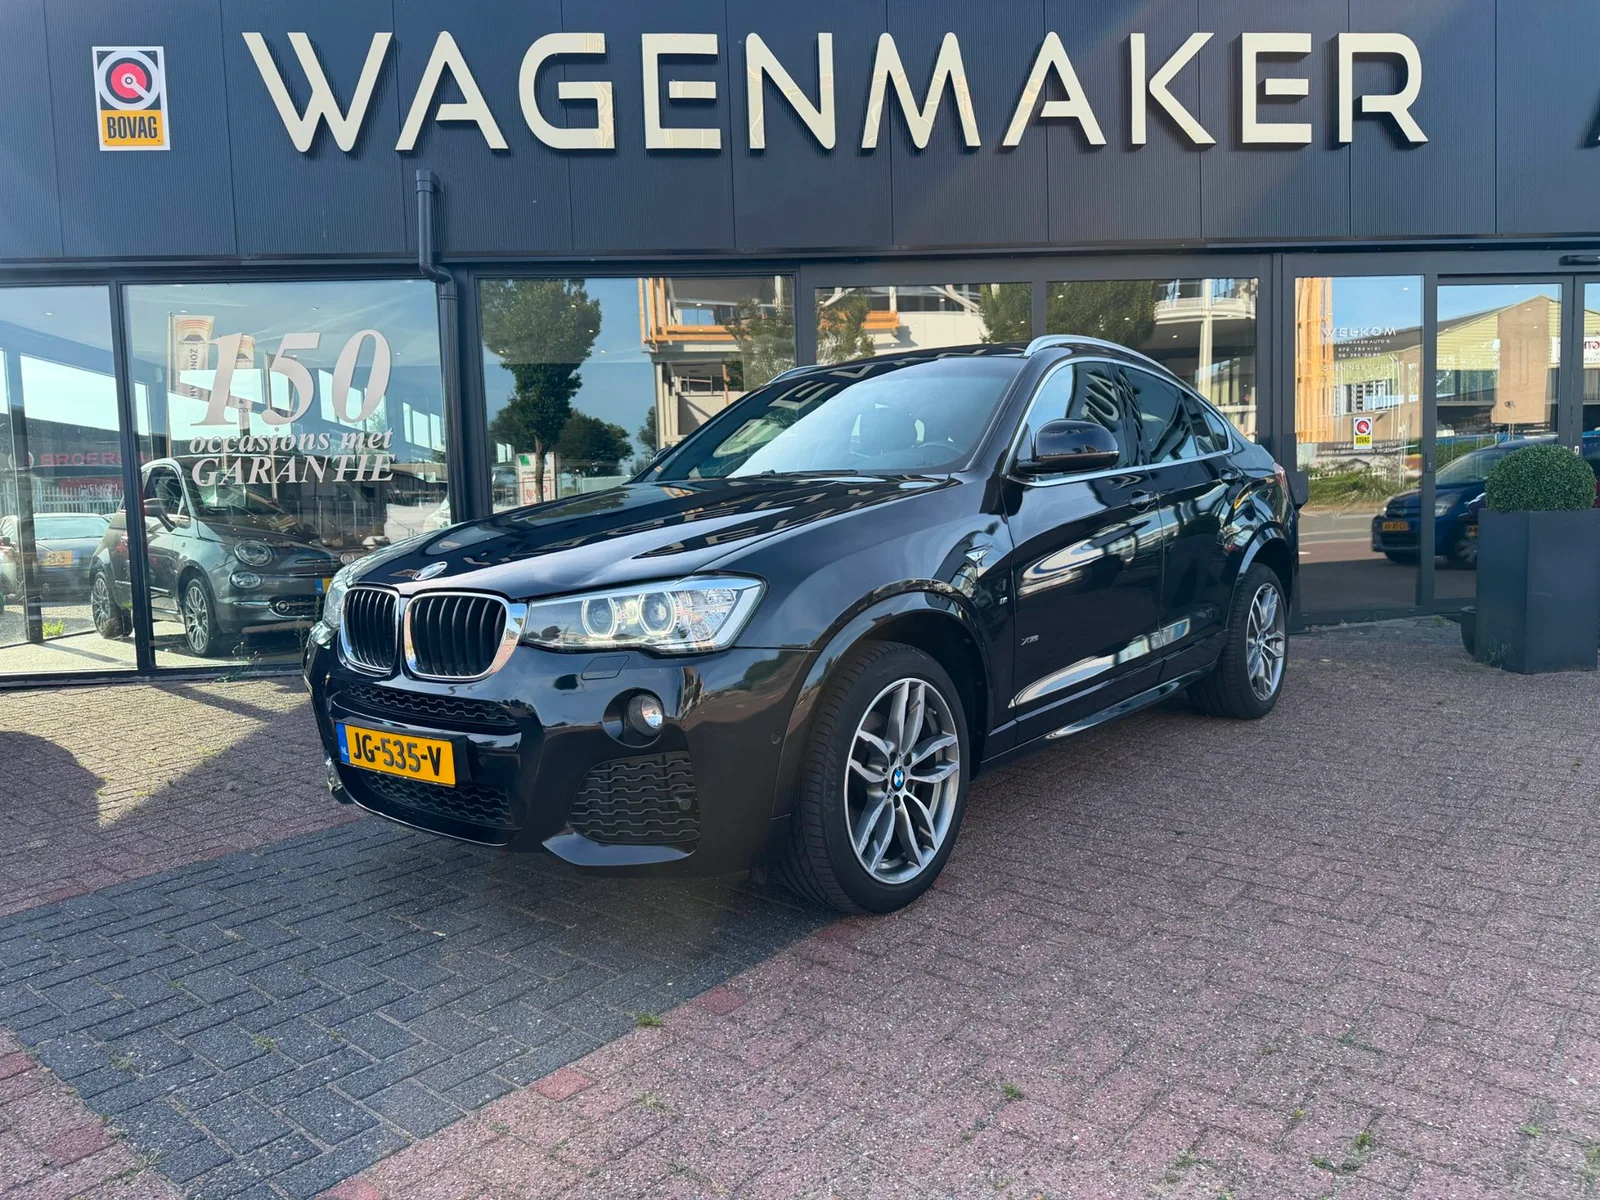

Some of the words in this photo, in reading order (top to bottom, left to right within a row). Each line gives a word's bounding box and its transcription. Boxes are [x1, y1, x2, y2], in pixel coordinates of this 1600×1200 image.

[242, 31, 1429, 153] WAGENMAKER
[106, 115, 158, 140] BOVAG
[1322, 326, 1397, 340] WELKOM
[190, 329, 392, 427] 150
[189, 428, 331, 454] occasions
[340, 428, 394, 450] met
[190, 453, 397, 487] GARANTIE
[353, 732, 442, 776] JG-535-V
